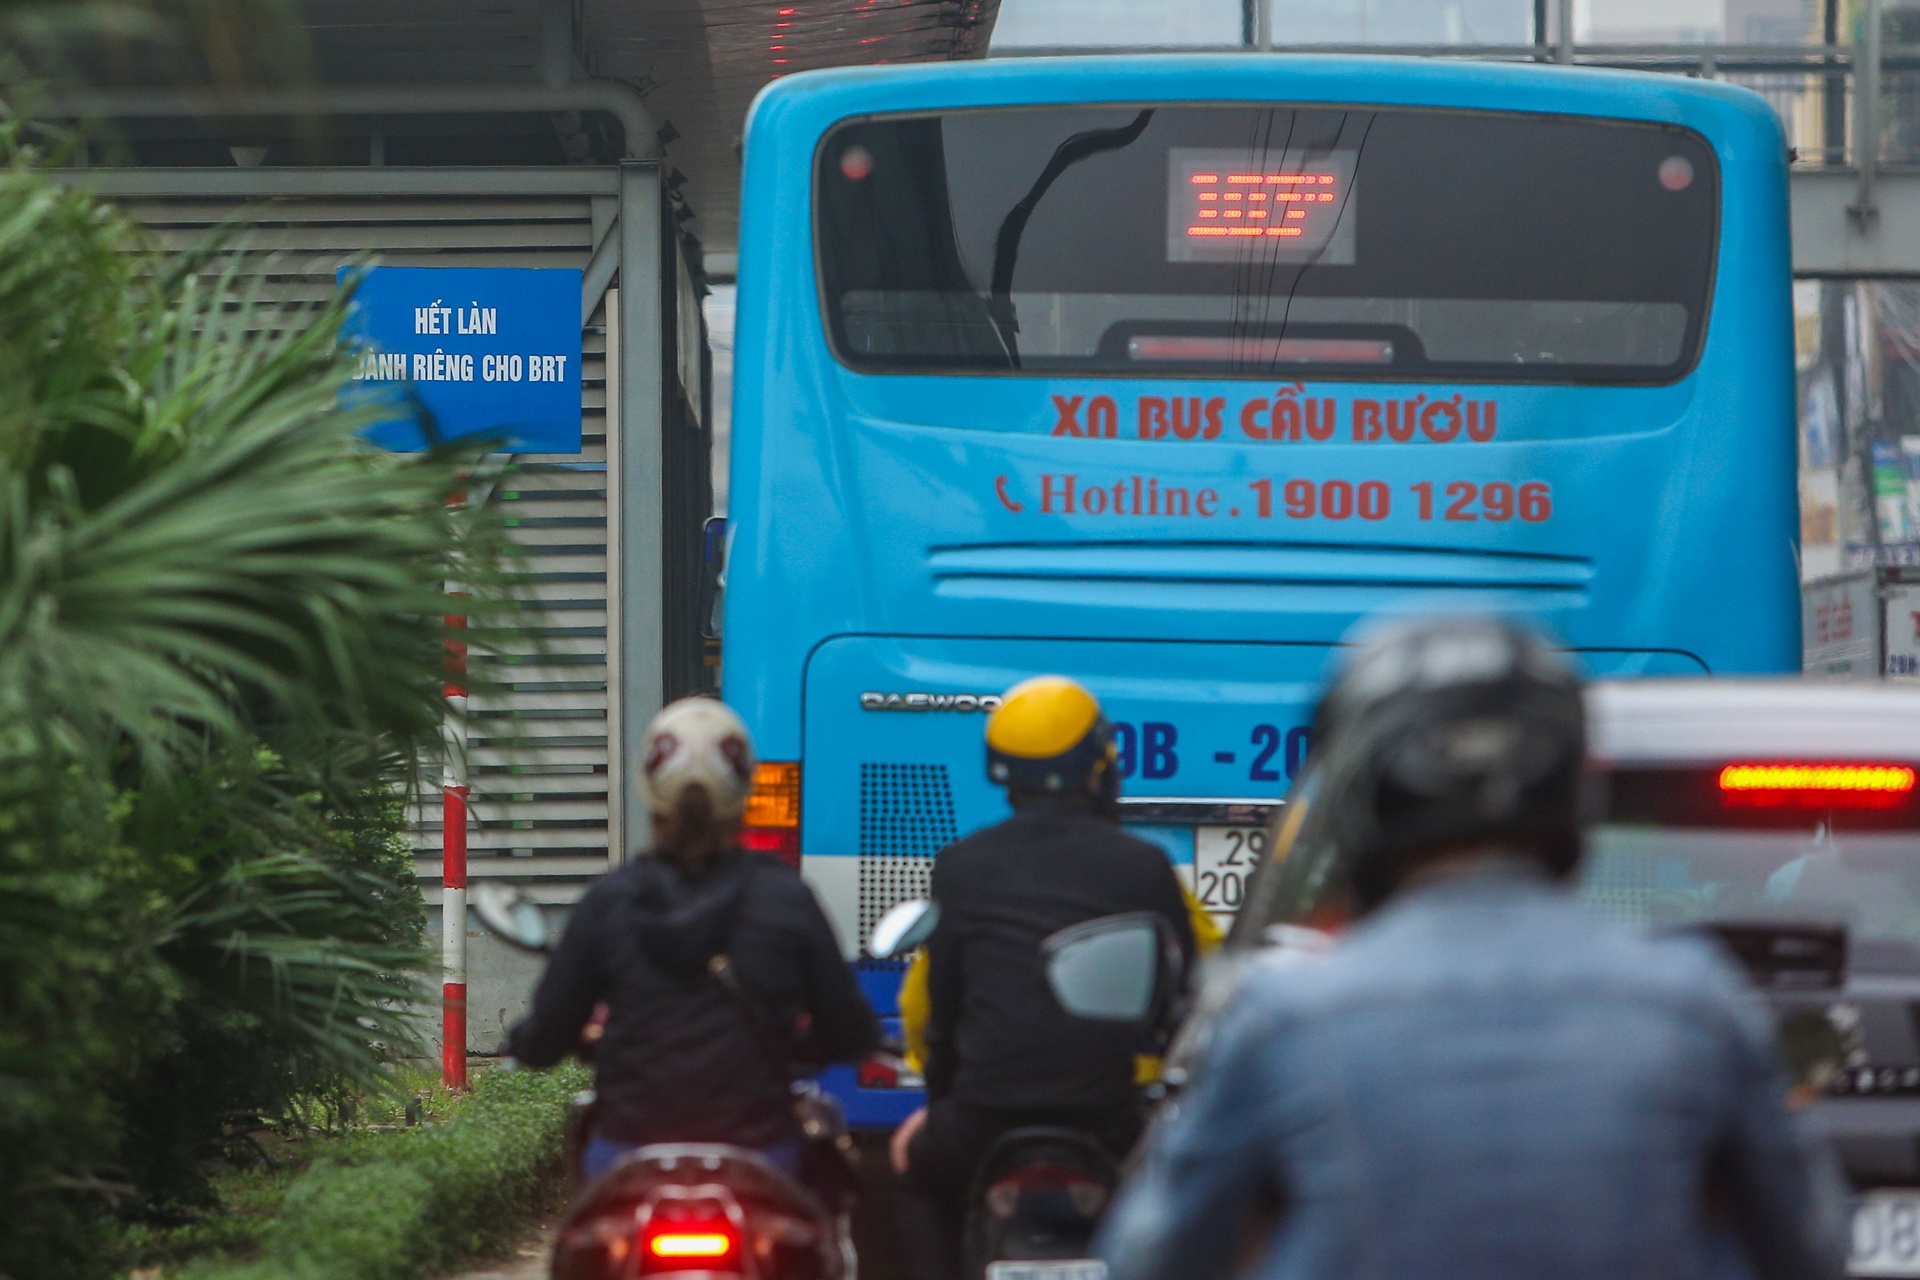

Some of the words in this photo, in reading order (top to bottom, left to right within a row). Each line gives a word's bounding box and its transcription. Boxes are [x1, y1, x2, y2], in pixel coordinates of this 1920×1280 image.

[415, 299, 451, 334] HẾT
[458, 301, 496, 334] LÀN
[413, 348, 474, 381] RIÊNG
[482, 355, 522, 381] CHO
[528, 355, 567, 382] BRT
[1138, 396, 1226, 440] BUS
[1240, 381, 1336, 441] CẦU
[1352, 393, 1497, 442] BƯƠU
[1249, 478, 1391, 520] 1900
[1410, 481, 1551, 523] 1296
[1111, 722, 1179, 780] 9B
[1250, 724, 1314, 782] 20
